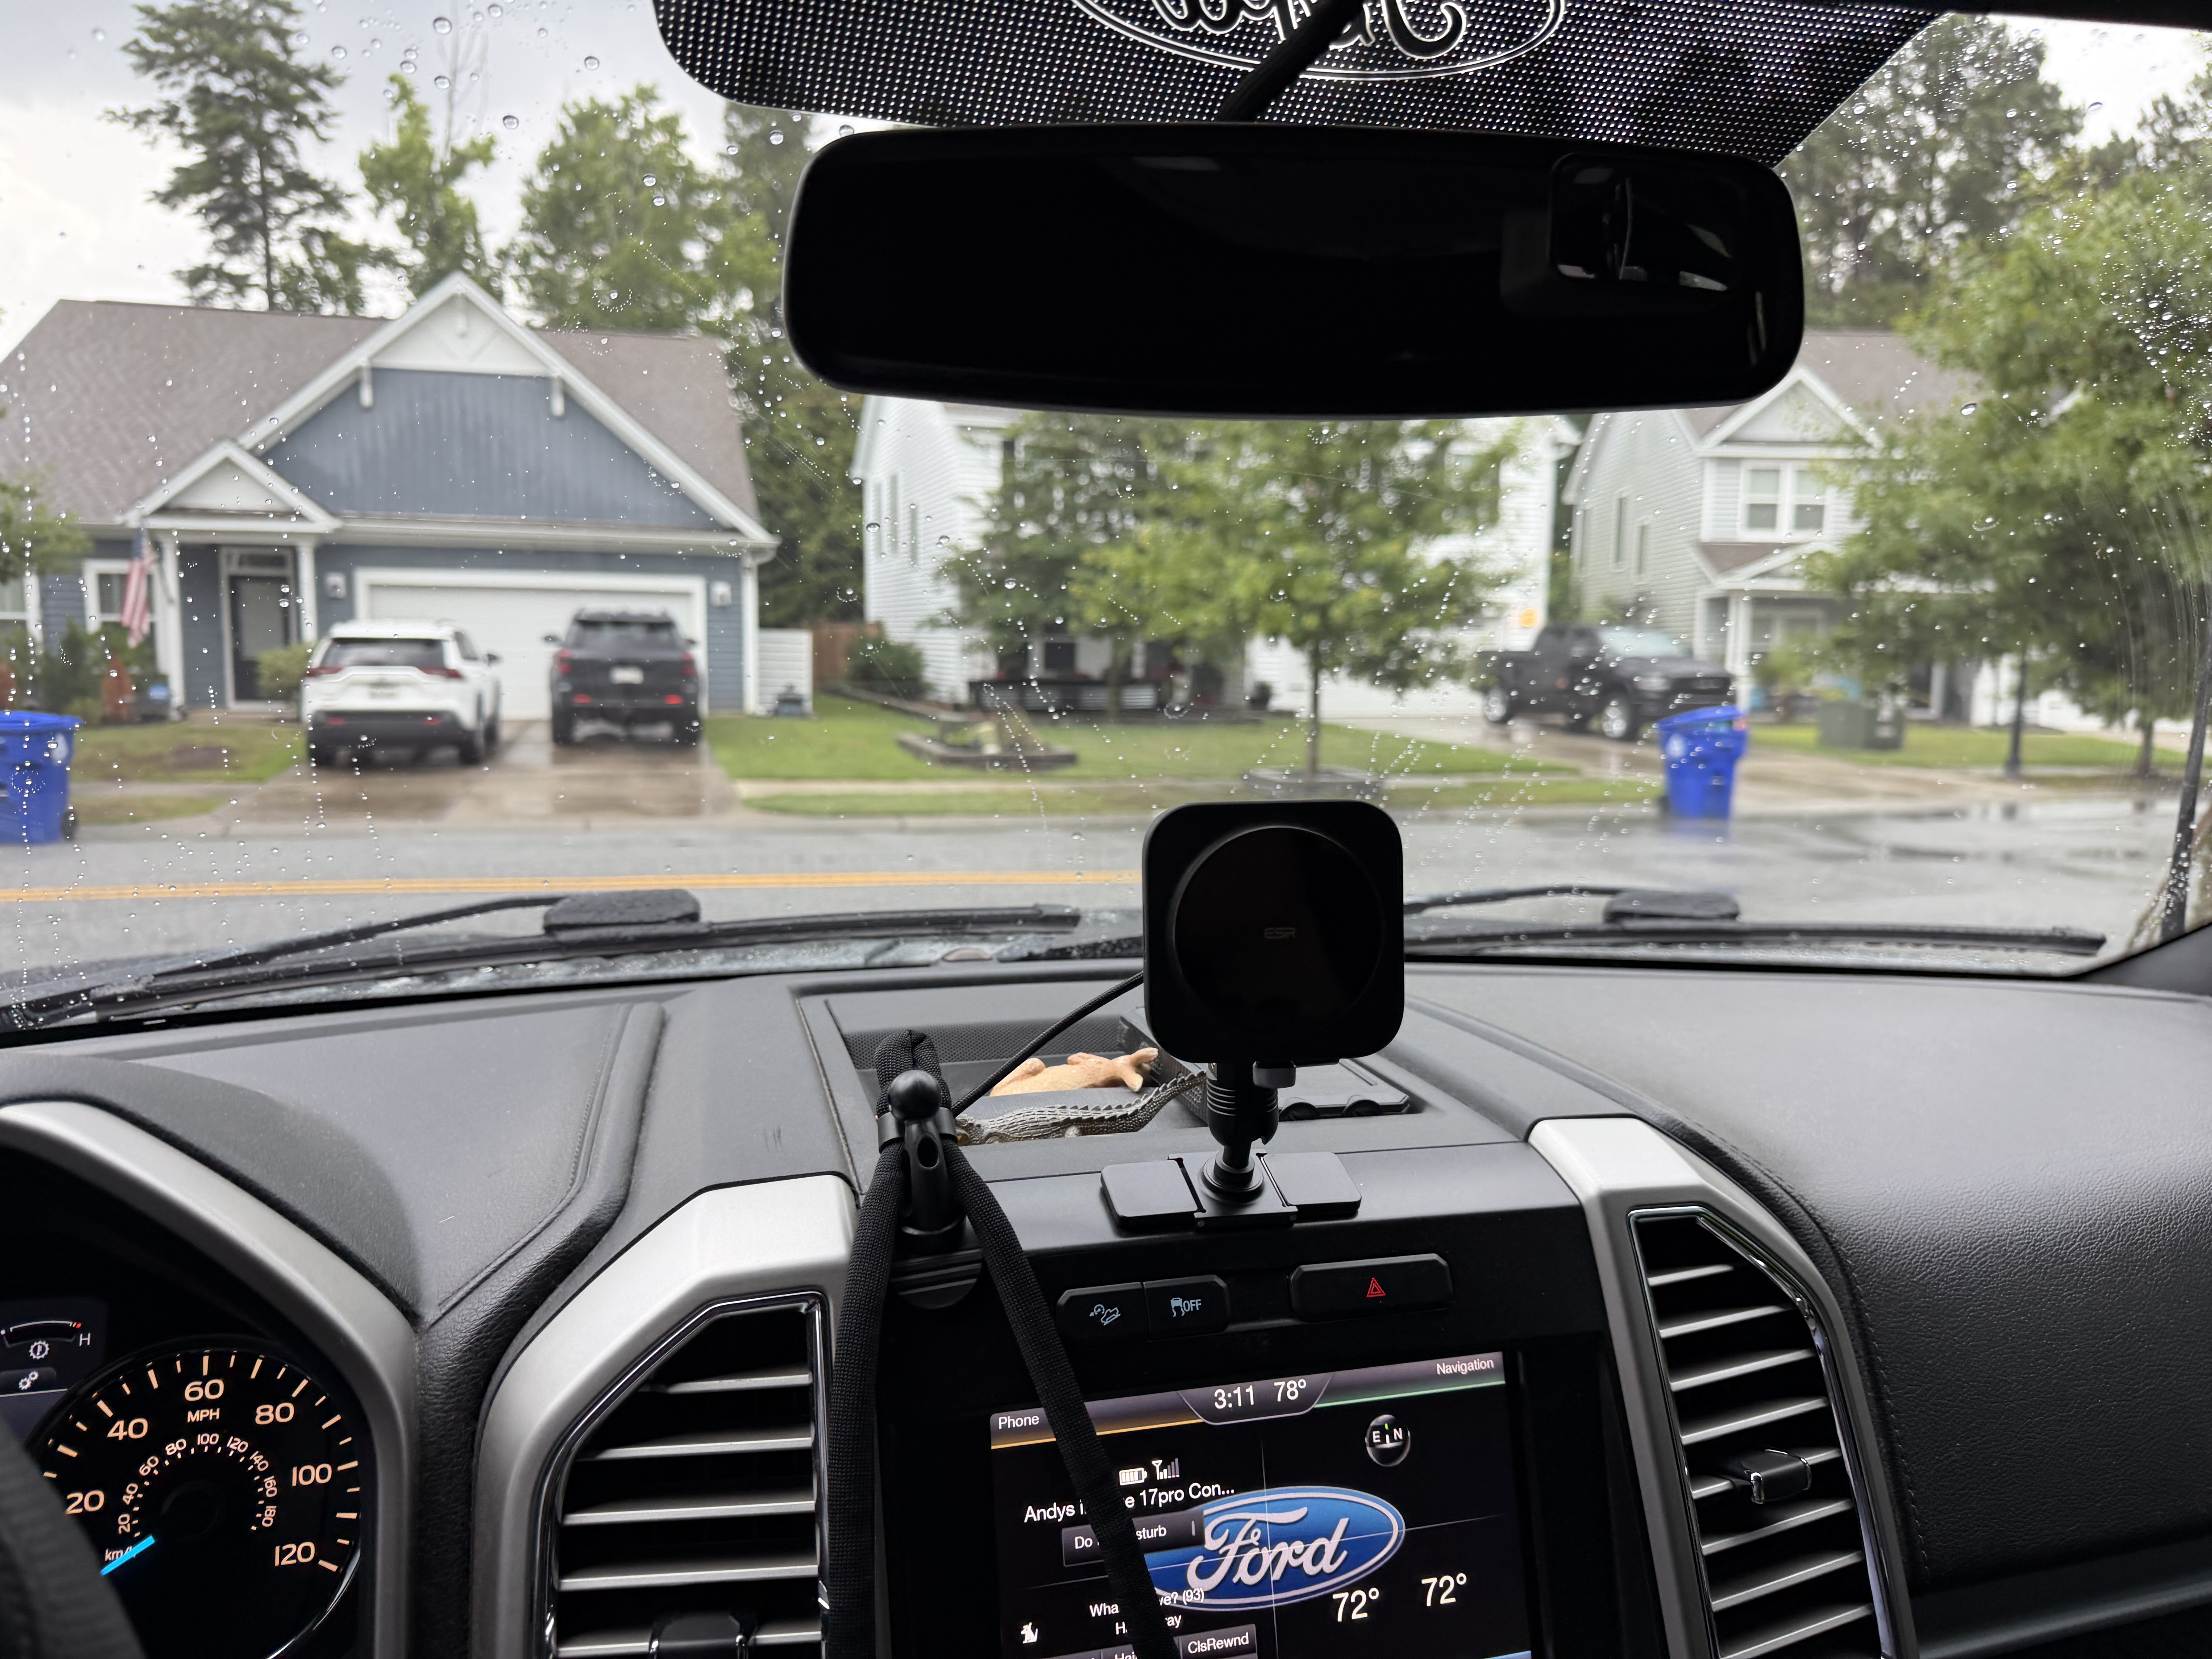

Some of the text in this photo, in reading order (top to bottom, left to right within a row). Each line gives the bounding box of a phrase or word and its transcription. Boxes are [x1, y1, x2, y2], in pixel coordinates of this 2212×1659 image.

[1264, 927, 1296, 939] ESR
[1183, 1299, 1202, 1312] OFF
[79, 1333, 91, 1346] H
[1437, 1358, 1494, 1375] Navigation
[185, 1380, 224, 1401] 60
[1214, 1379, 1307, 1409] 3:11 78°
[188, 1408, 220, 1423] MPH
[256, 1403, 294, 1425] 80
[998, 1415, 1040, 1430] Phone
[107, 1418, 148, 1440] 40
[197, 1433, 219, 1446] 100
[165, 1439, 187, 1456] 80
[227, 1436, 249, 1453] 120
[140, 1456, 159, 1476] 60
[250, 1451, 269, 1472] 140
[263, 1475, 278, 1498] 160
[293, 1464, 332, 1487] 100
[66, 1491, 105, 1515] 20
[122, 1483, 139, 1505] 40
[261, 1505, 276, 1528] 180
[1025, 1503, 1075, 1523] Andys
[1140, 1489, 1185, 1508] 17pro
[118, 1515, 131, 1534] 20
[1075, 1525, 1167, 1549] Do sturb
[275, 1542, 315, 1566] 120
[1187, 1506, 1350, 1591] Ford
[1422, 1573, 1467, 1607] 72°
[1090, 1603, 1119, 1617] Wha
[1183, 1588, 1204, 1605] (93)
[1333, 1587, 1380, 1623] 72°
[1188, 1633, 1249, 1654] ClsRewnd
